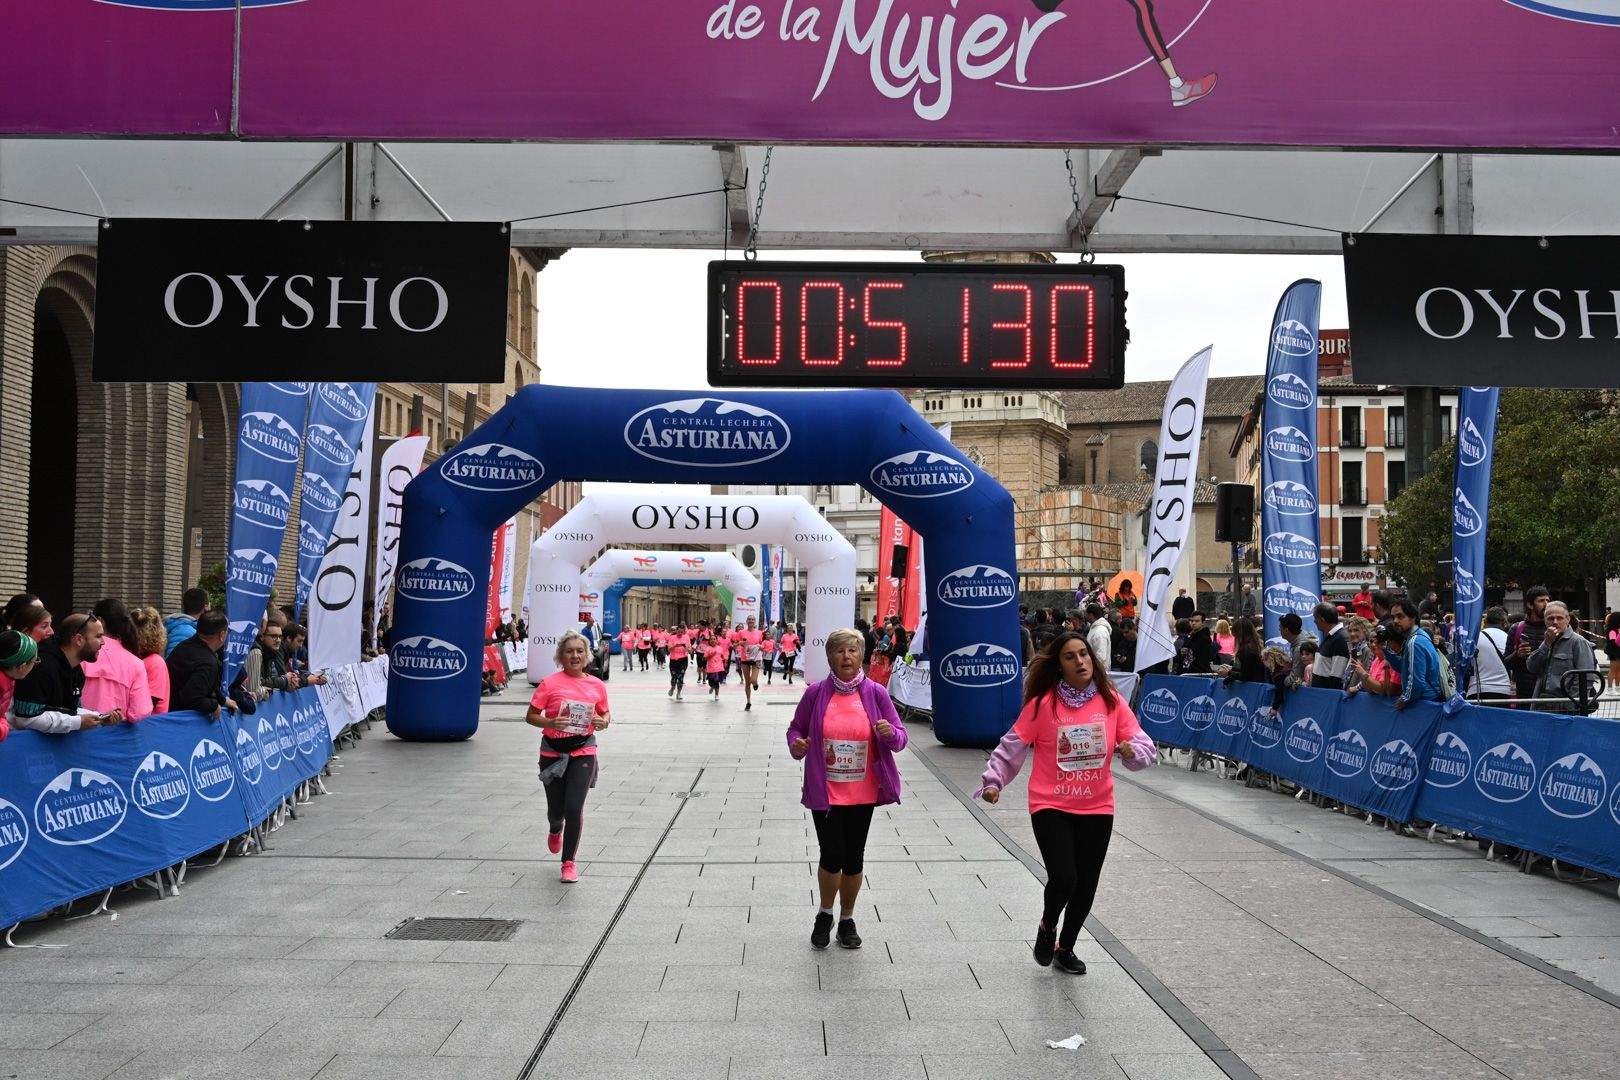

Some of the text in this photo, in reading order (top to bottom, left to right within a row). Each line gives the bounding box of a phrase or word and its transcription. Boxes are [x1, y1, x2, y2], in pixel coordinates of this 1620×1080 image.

[706, 0, 1067, 121] de la Mujer
[163, 272, 449, 333] OYSHO
[663, 417, 773, 427] CENTRAL LECHERA
[241, 420, 299, 457] ASTURIANA
[637, 418, 779, 450] ASTURIANA
[307, 429, 349, 462] ASTURIANA
[447, 459, 536, 480] ASTURIANA
[880, 469, 968, 486] ASTURIANA
[302, 484, 337, 509] STURIANA
[631, 504, 760, 531] OYSHO
[554, 532, 593, 542] OYSHO
[795, 533, 833, 542] OYSHO
[1267, 541, 1317, 561] ASTRIANA
[399, 572, 469, 592] ASTURIANA
[535, 583, 572, 593] OYSHO
[814, 586, 850, 596] OYSHO
[943, 581, 1013, 599] ASTURIANA
[392, 649, 461, 670] ASTURIANA
[945, 660, 1016, 677] ASTURIANA
[1072, 741, 1090, 750] 016
[194, 763, 233, 790] ASTURIANA
[1429, 757, 1466, 777] TURIANA
[1478, 760, 1530, 791] ASTURIANA
[140, 779, 188, 807] ASTURIANA
[1053, 784, 1092, 796] SUMA
[1542, 772, 1599, 806] ASTURIANA
[54, 793, 86, 807] CENTRAL
[45, 796, 124, 834] ASTURIANA
